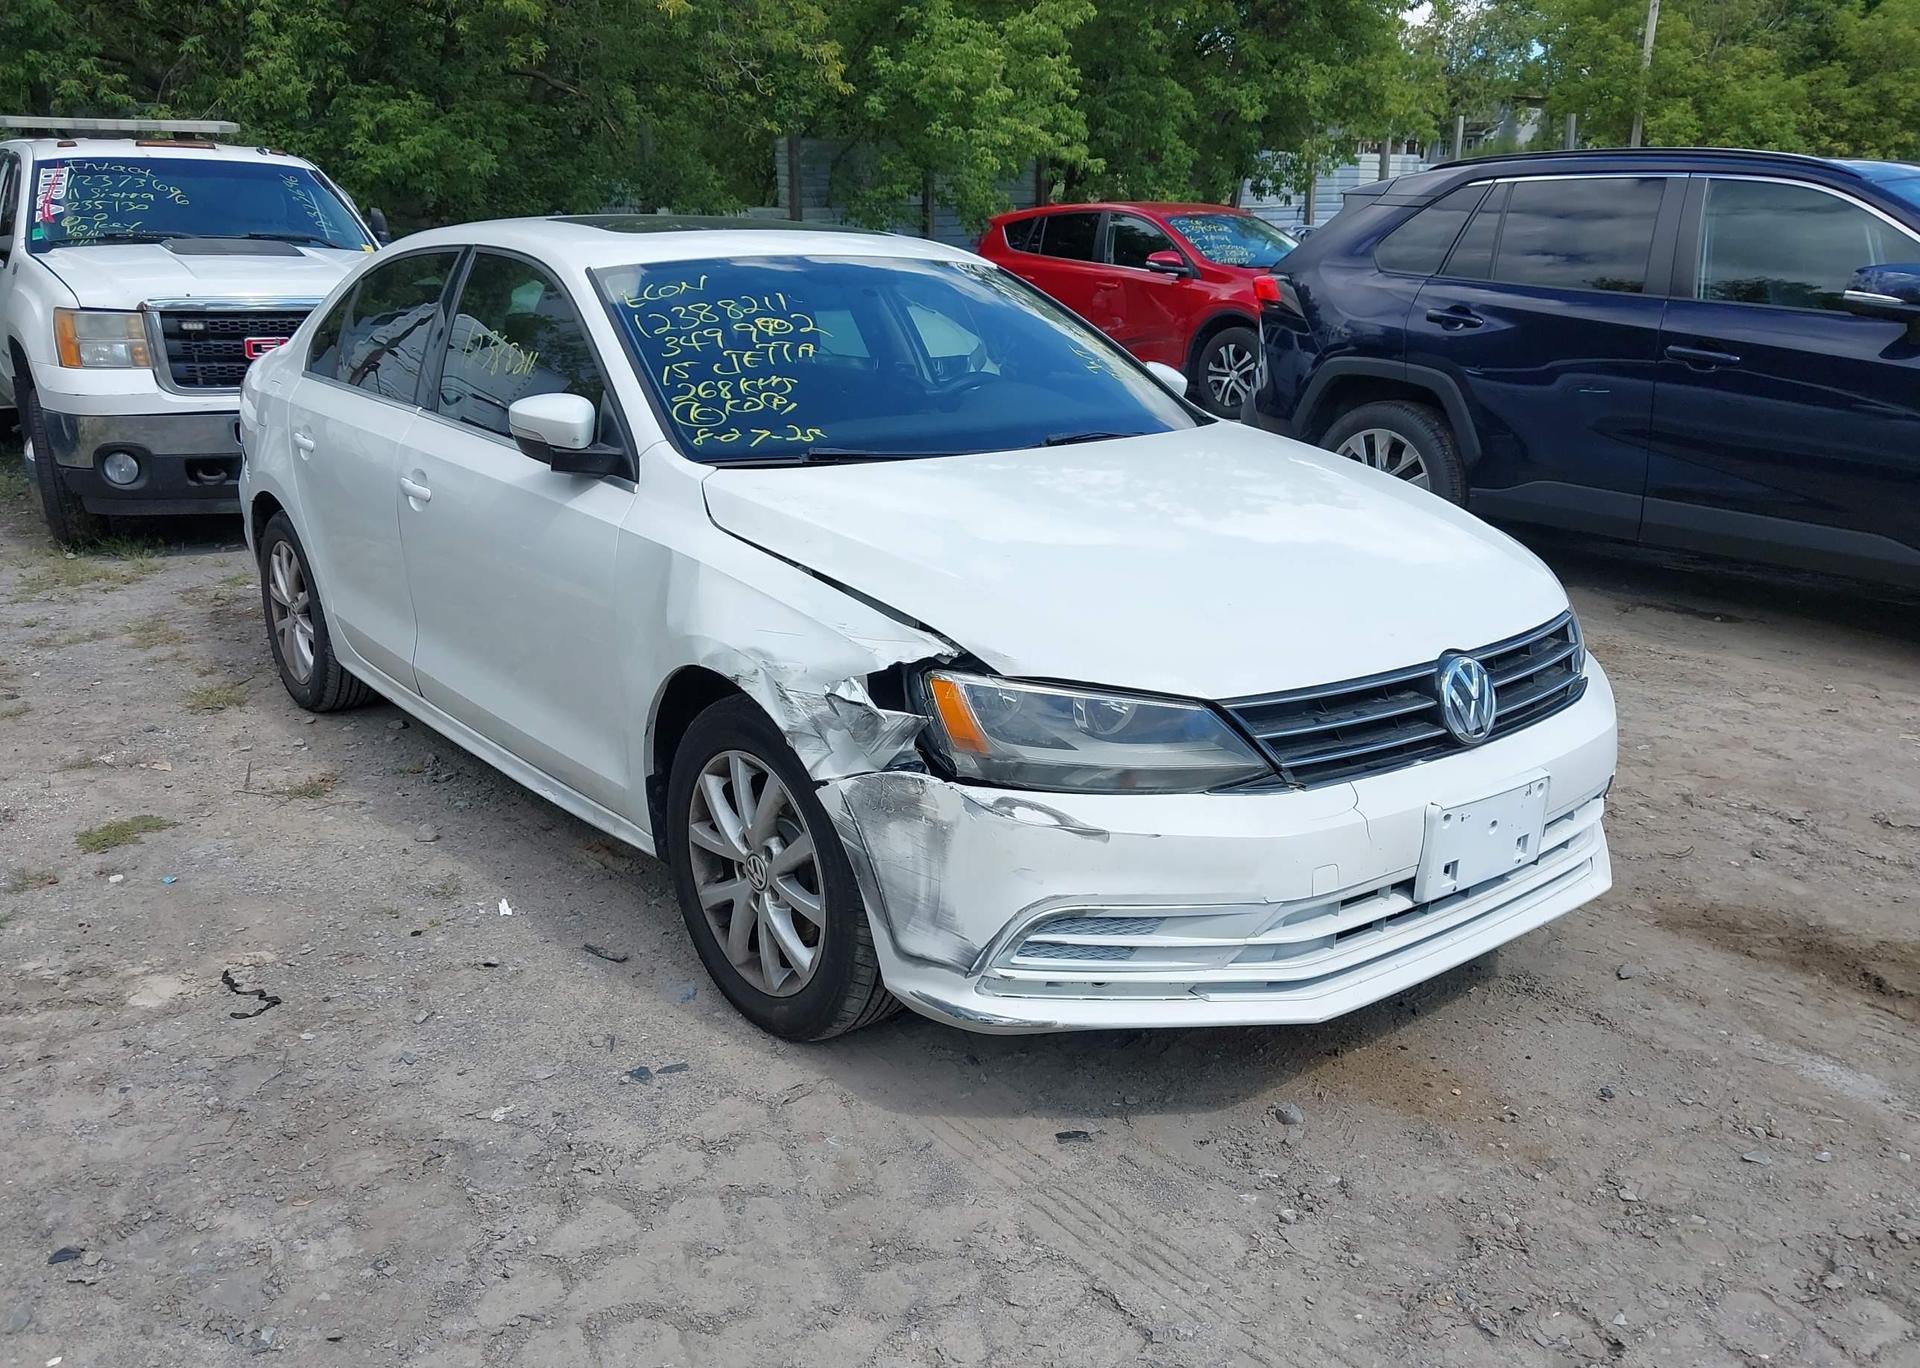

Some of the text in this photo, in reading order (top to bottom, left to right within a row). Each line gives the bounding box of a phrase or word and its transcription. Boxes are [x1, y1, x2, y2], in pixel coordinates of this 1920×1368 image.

[67, 173, 190, 206] 12373696
[712, 341, 816, 375] JETTA
[671, 380, 734, 402] 268
